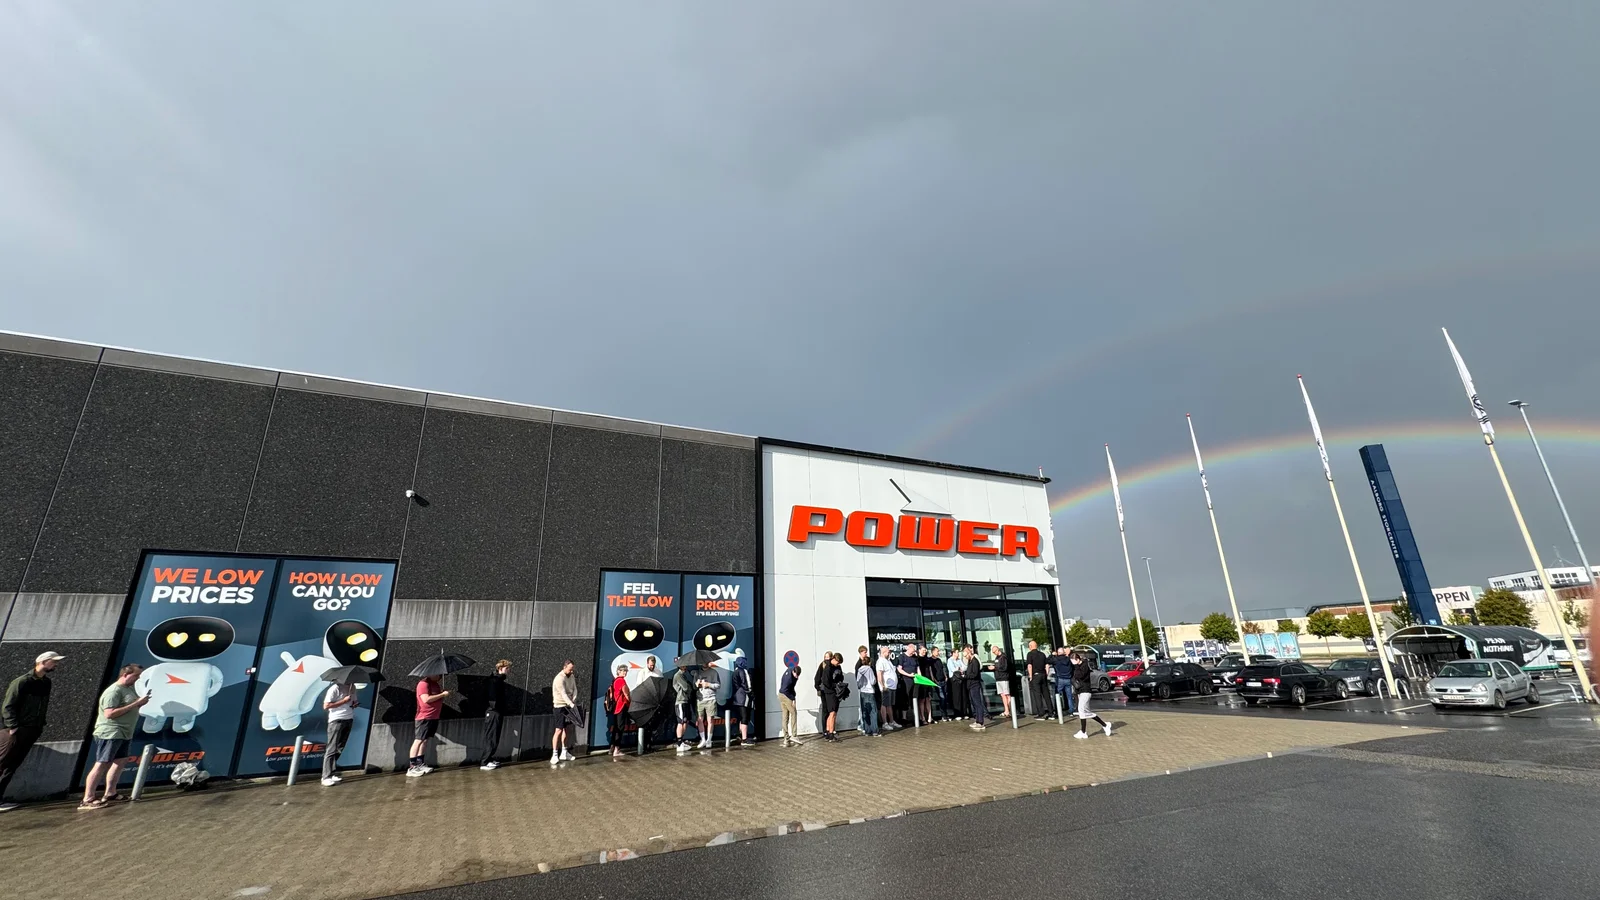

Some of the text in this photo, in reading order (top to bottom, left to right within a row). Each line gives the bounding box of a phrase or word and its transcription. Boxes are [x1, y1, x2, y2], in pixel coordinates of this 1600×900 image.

[1371, 480, 1399, 559] AALBORG STORCENTER
[787, 505, 1040, 558] POWER
[154, 568, 264, 585] WE LOW
[289, 572, 382, 586] HOW LOW
[150, 586, 255, 604] PRICES
[292, 585, 375, 598] CAN YOU
[623, 582, 658, 595] FEEL
[696, 583, 740, 600] LOW
[607, 595, 673, 608] THE LOW
[1433, 591, 1470, 603] PPEN
[313, 598, 351, 611] GO?
[696, 600, 740, 611] PRICES
[876, 632, 916, 640] ÅBNINGSTIDER
[1483, 645, 1514, 653] NOTHING
[265, 743, 327, 756] POWE
